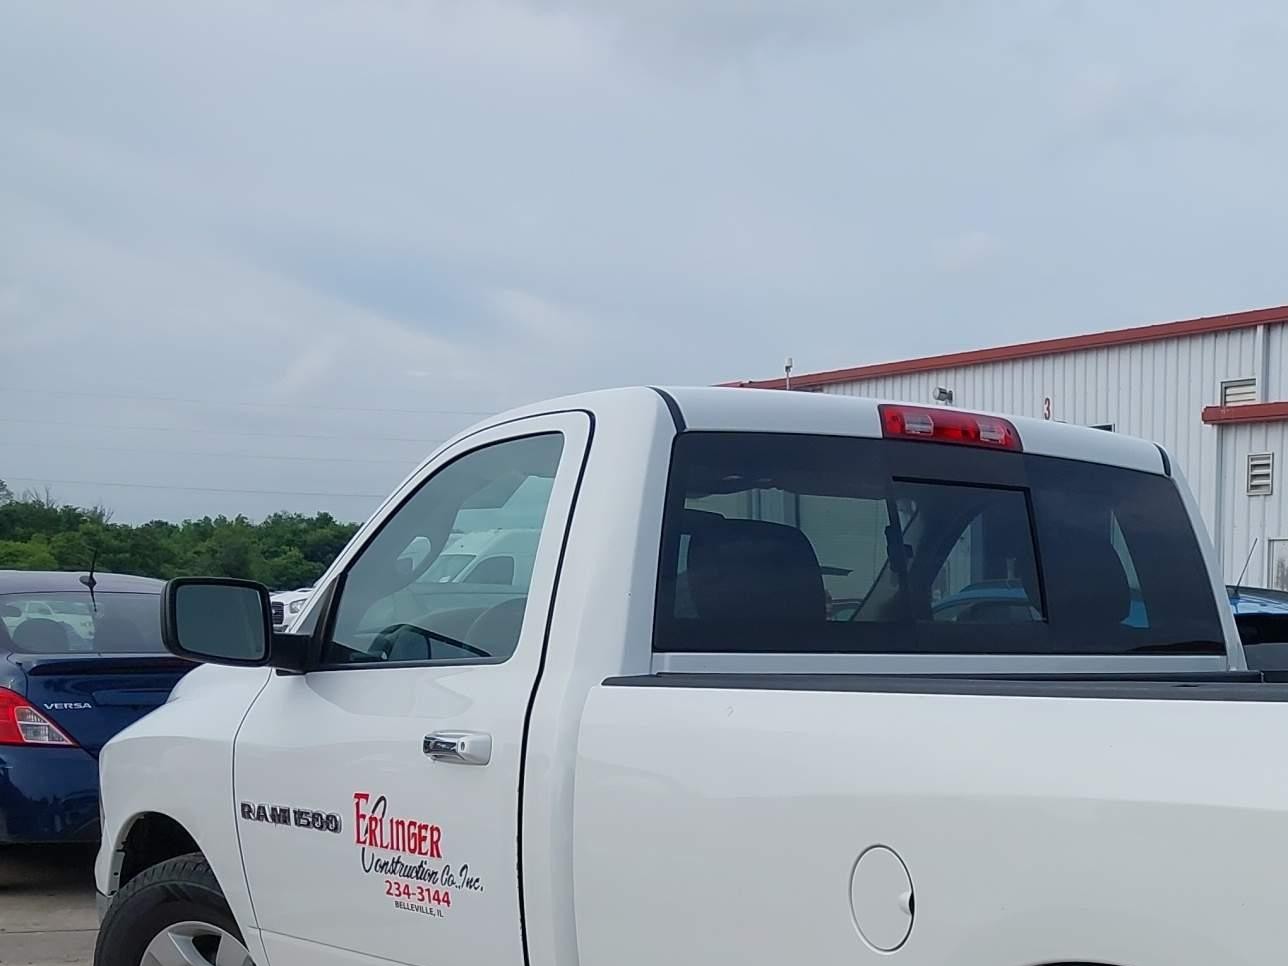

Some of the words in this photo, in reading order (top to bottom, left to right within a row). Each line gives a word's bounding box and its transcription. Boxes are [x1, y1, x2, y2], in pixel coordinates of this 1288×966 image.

[1043, 397, 1051, 421] 3
[43, 702, 92, 710] VERSA
[240, 802, 291, 826] RAM
[293, 808, 342, 834] 1500
[385, 880, 451, 907] 234-3144
[394, 900, 436, 917] BELLEVILLE,
[436, 909, 444, 918] IL
